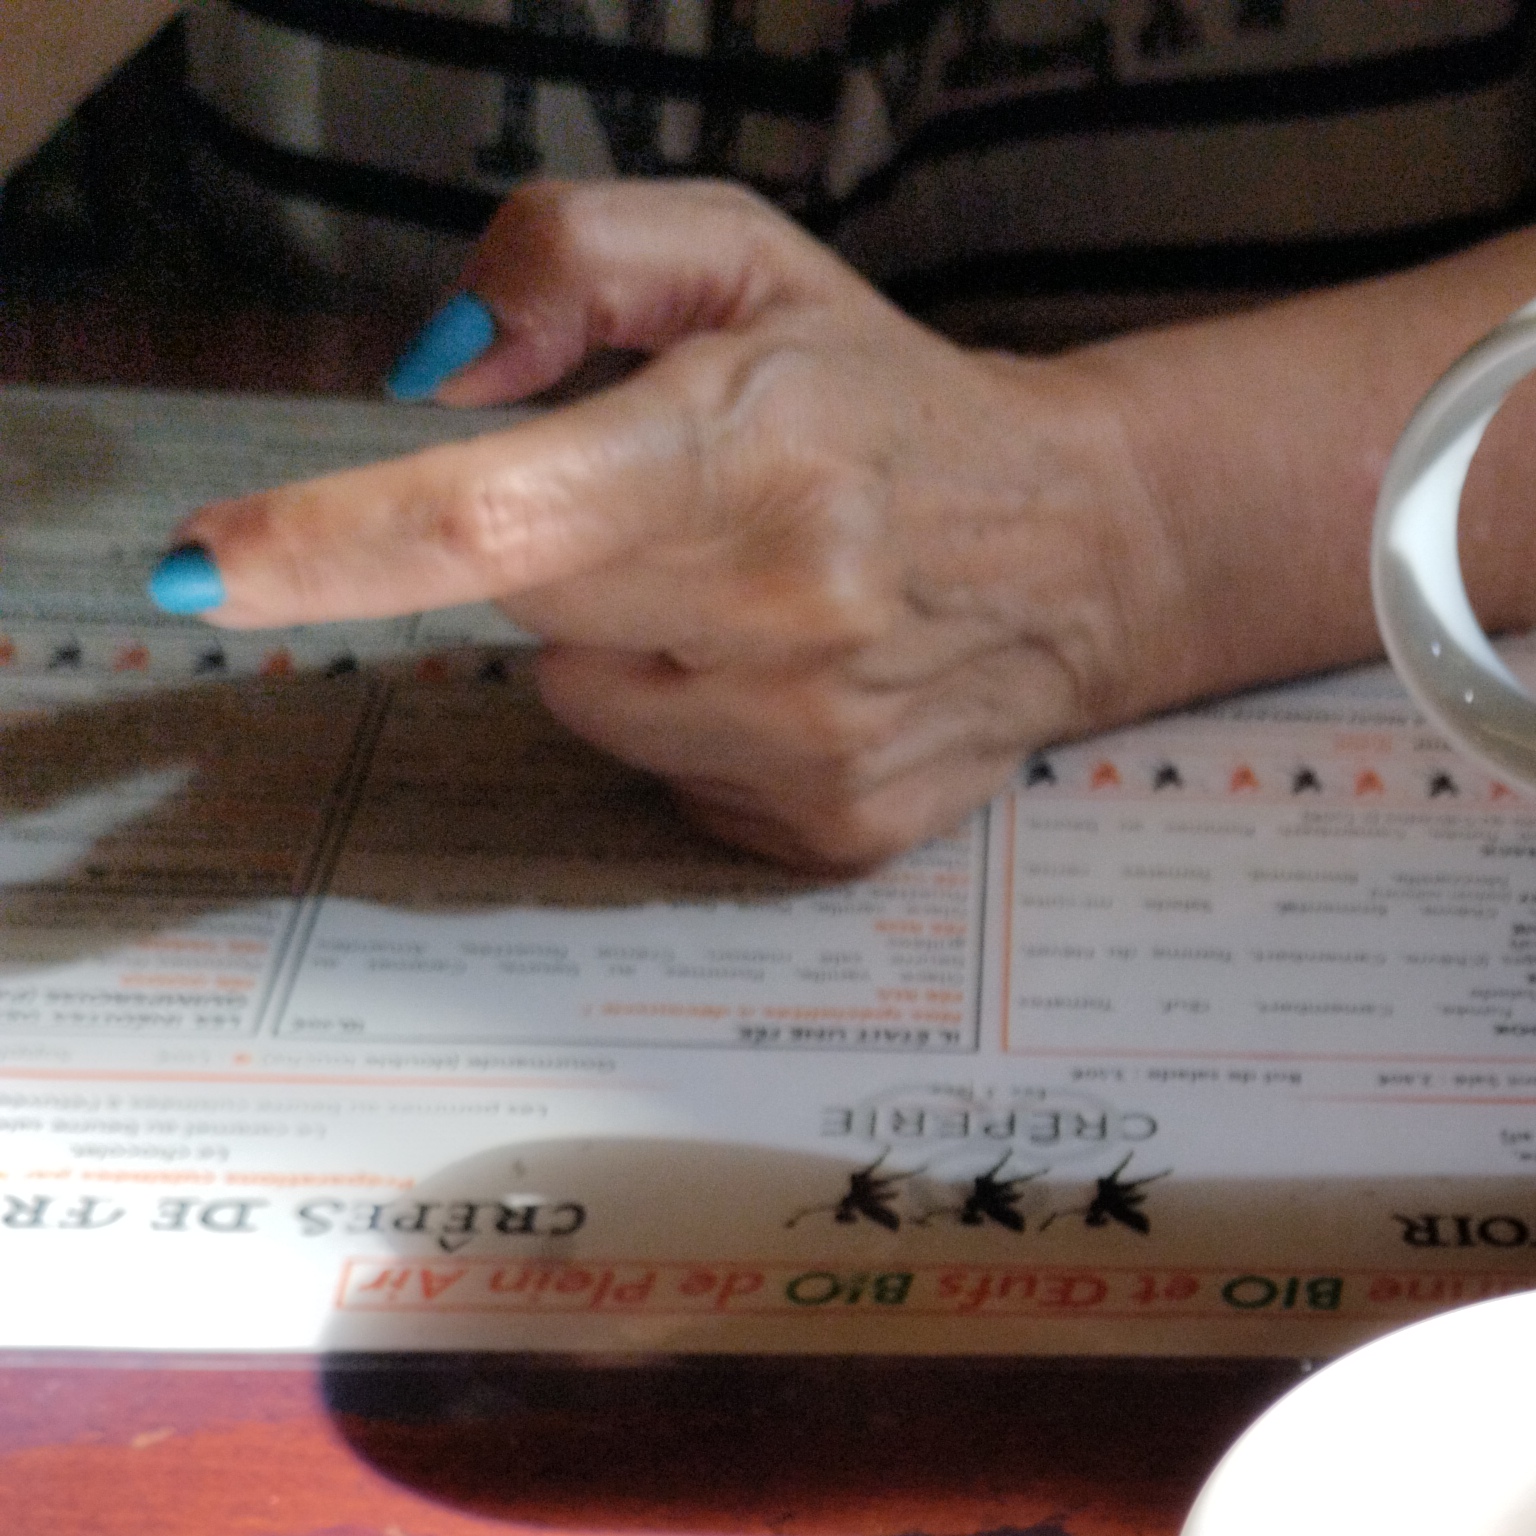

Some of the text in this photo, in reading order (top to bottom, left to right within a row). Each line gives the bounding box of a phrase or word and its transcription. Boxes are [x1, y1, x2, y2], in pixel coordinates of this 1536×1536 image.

[150, 1199, 272, 1236] DE
[294, 1200, 588, 1255] CRÊPES
[355, 1266, 466, 1308] Air
[488, 1266, 658, 1312] Plein
[679, 1270, 765, 1311] de
[784, 1271, 916, 1306] BIO
[1130, 1273, 1200, 1308] et
[1220, 1274, 1343, 1311] BIO
